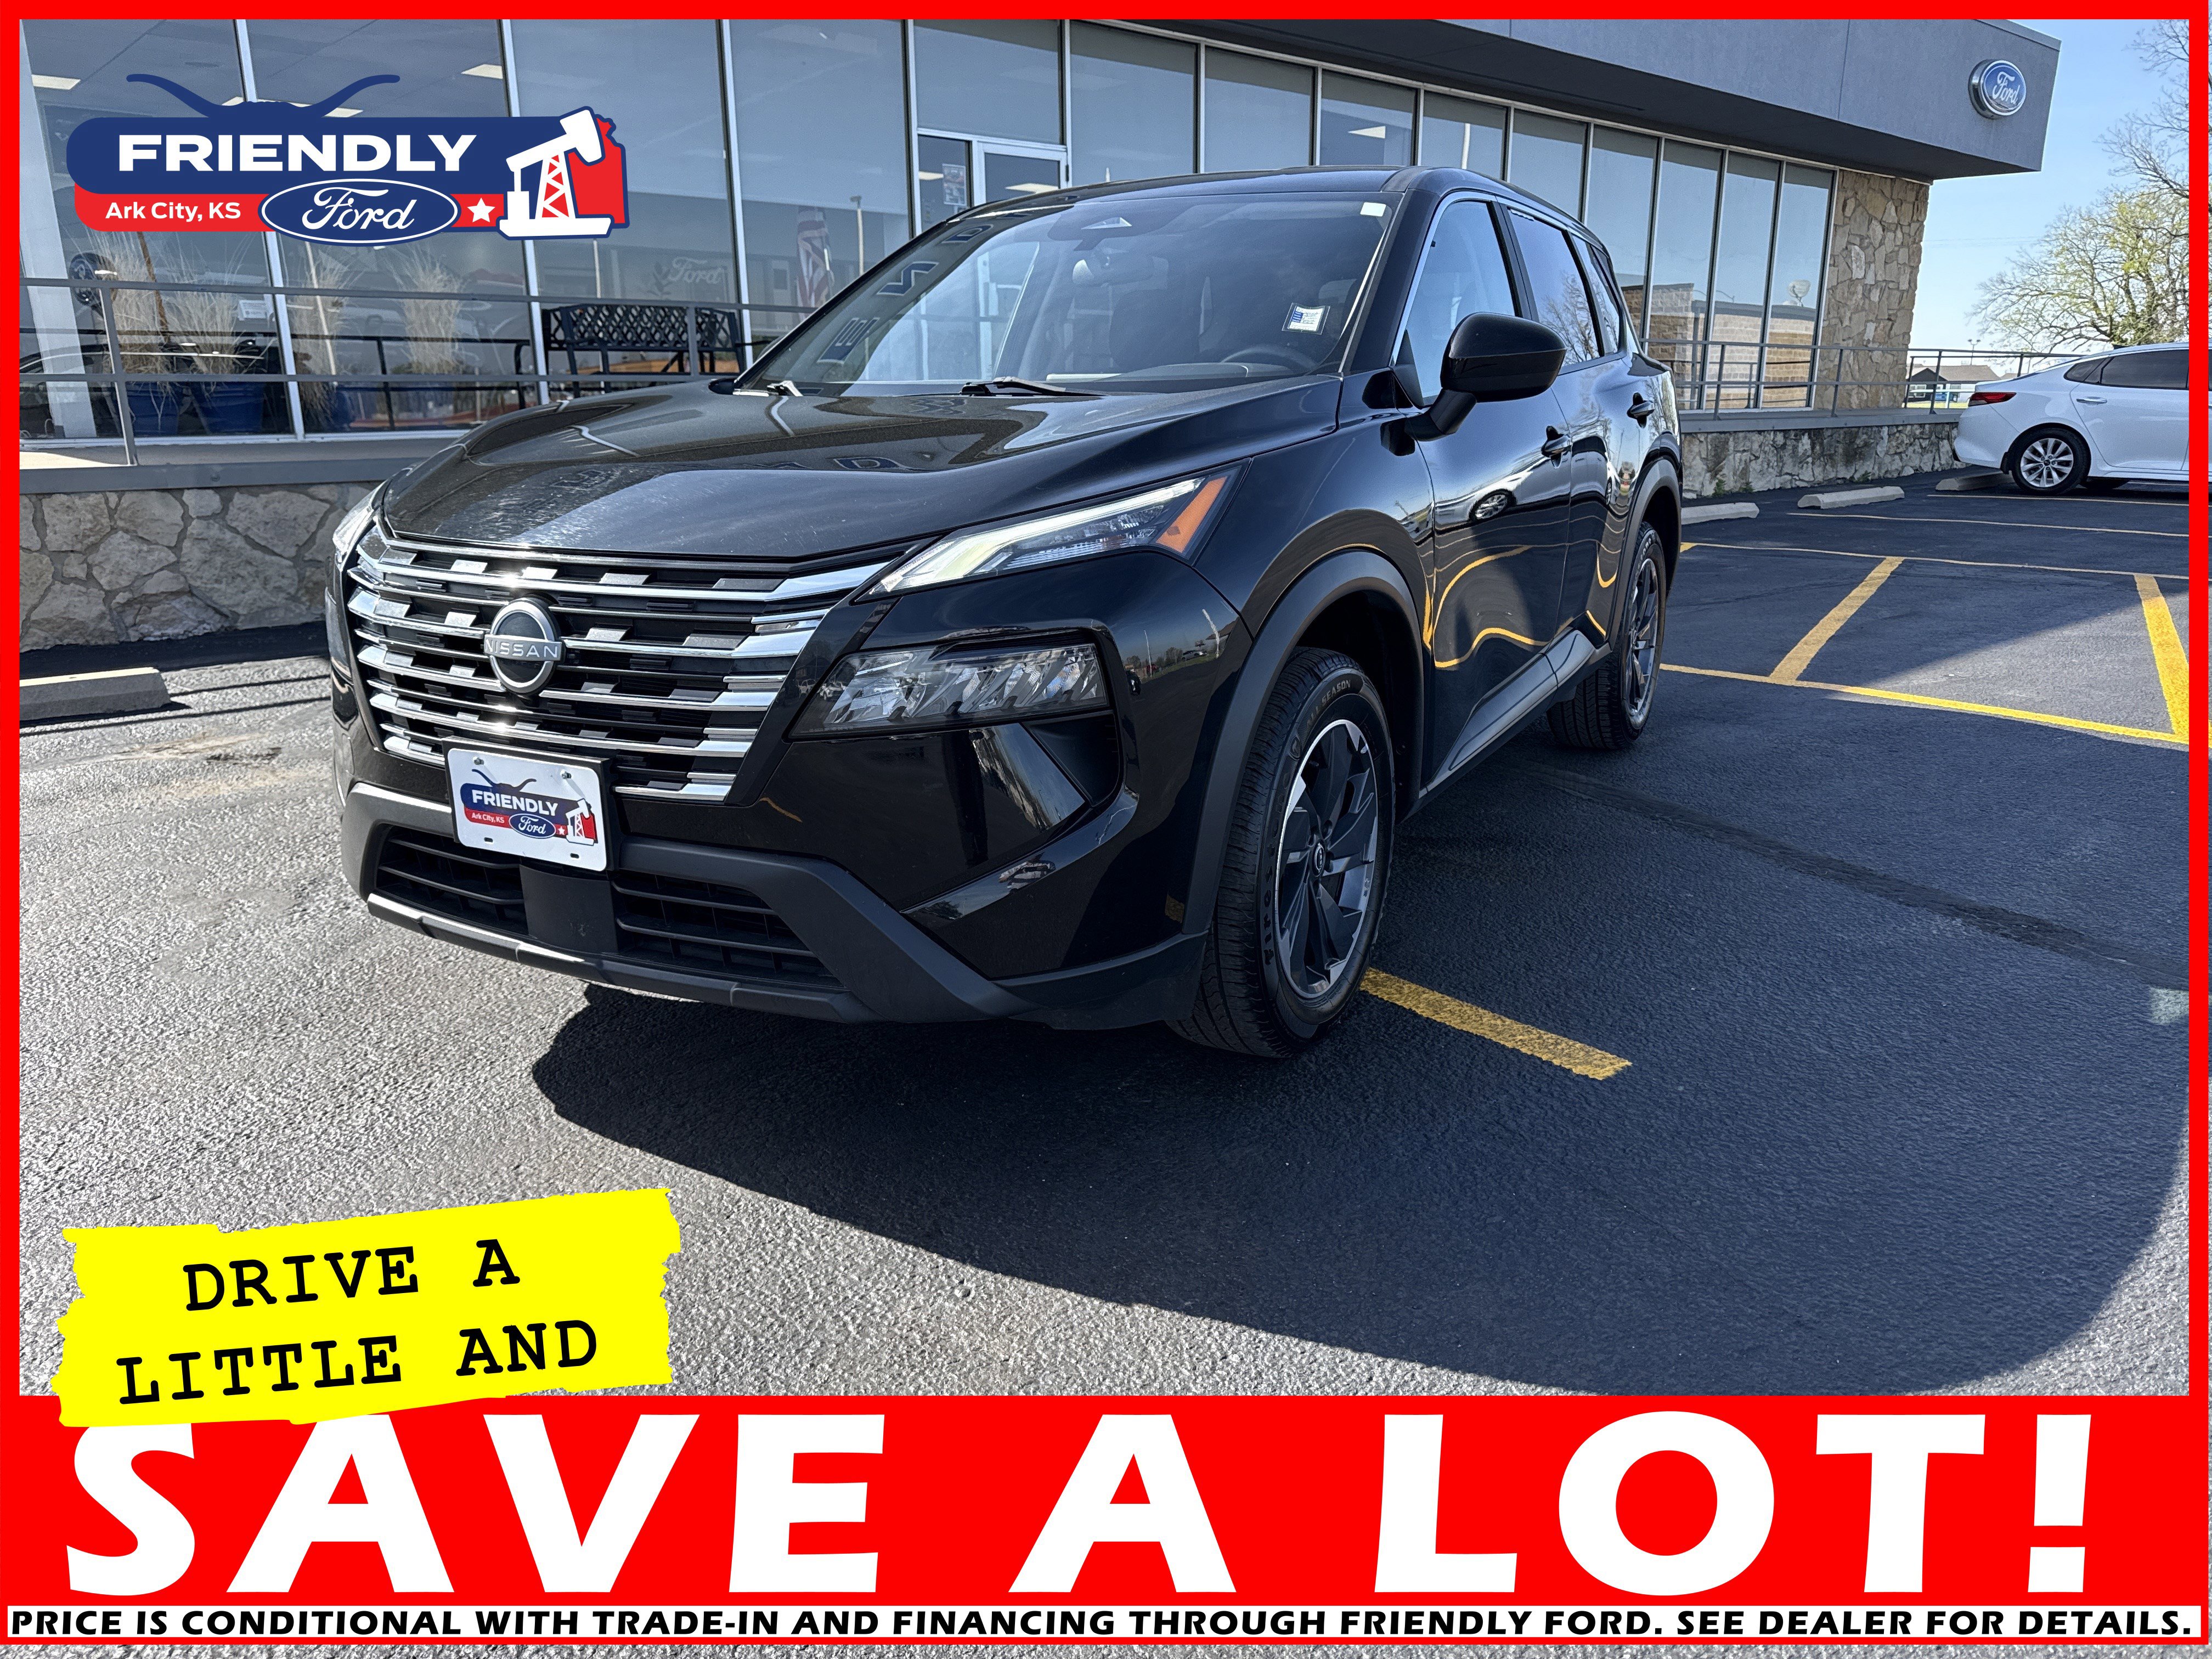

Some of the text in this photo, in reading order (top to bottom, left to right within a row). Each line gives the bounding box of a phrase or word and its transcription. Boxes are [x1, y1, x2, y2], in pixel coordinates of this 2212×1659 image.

[1992, 71, 2021, 104] Ford
[667, 256, 724, 284] Ford
[485, 639, 558, 658] NISSAN
[1321, 679, 1352, 706] SEASON
[472, 789, 558, 816] FRIENDLY
[518, 816, 546, 834] Ford
